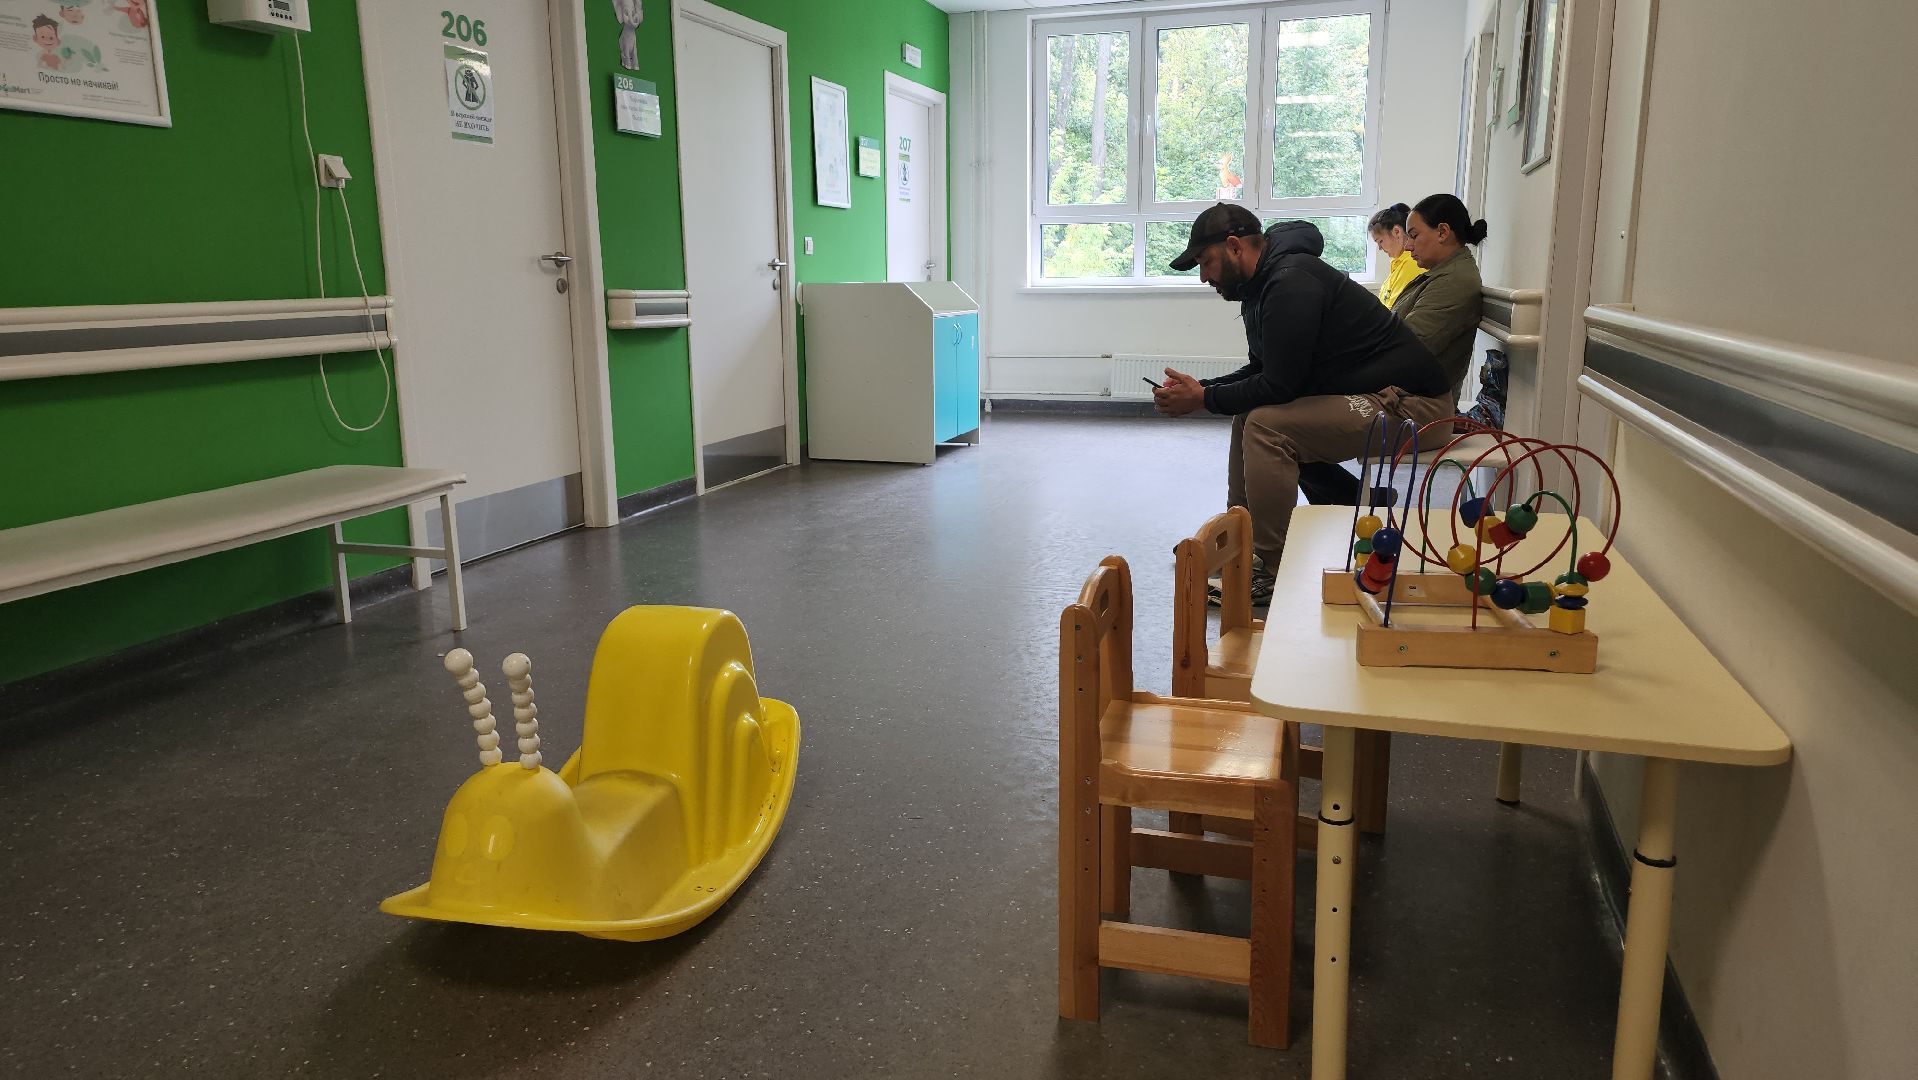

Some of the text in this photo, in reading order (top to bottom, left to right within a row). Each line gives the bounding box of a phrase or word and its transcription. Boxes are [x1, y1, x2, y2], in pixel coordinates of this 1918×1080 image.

[441, 10, 487, 46] 206
[38, 71, 119, 91] Просто не начинай!
[617, 76, 634, 90] 206
[899, 136, 911, 152] 207
